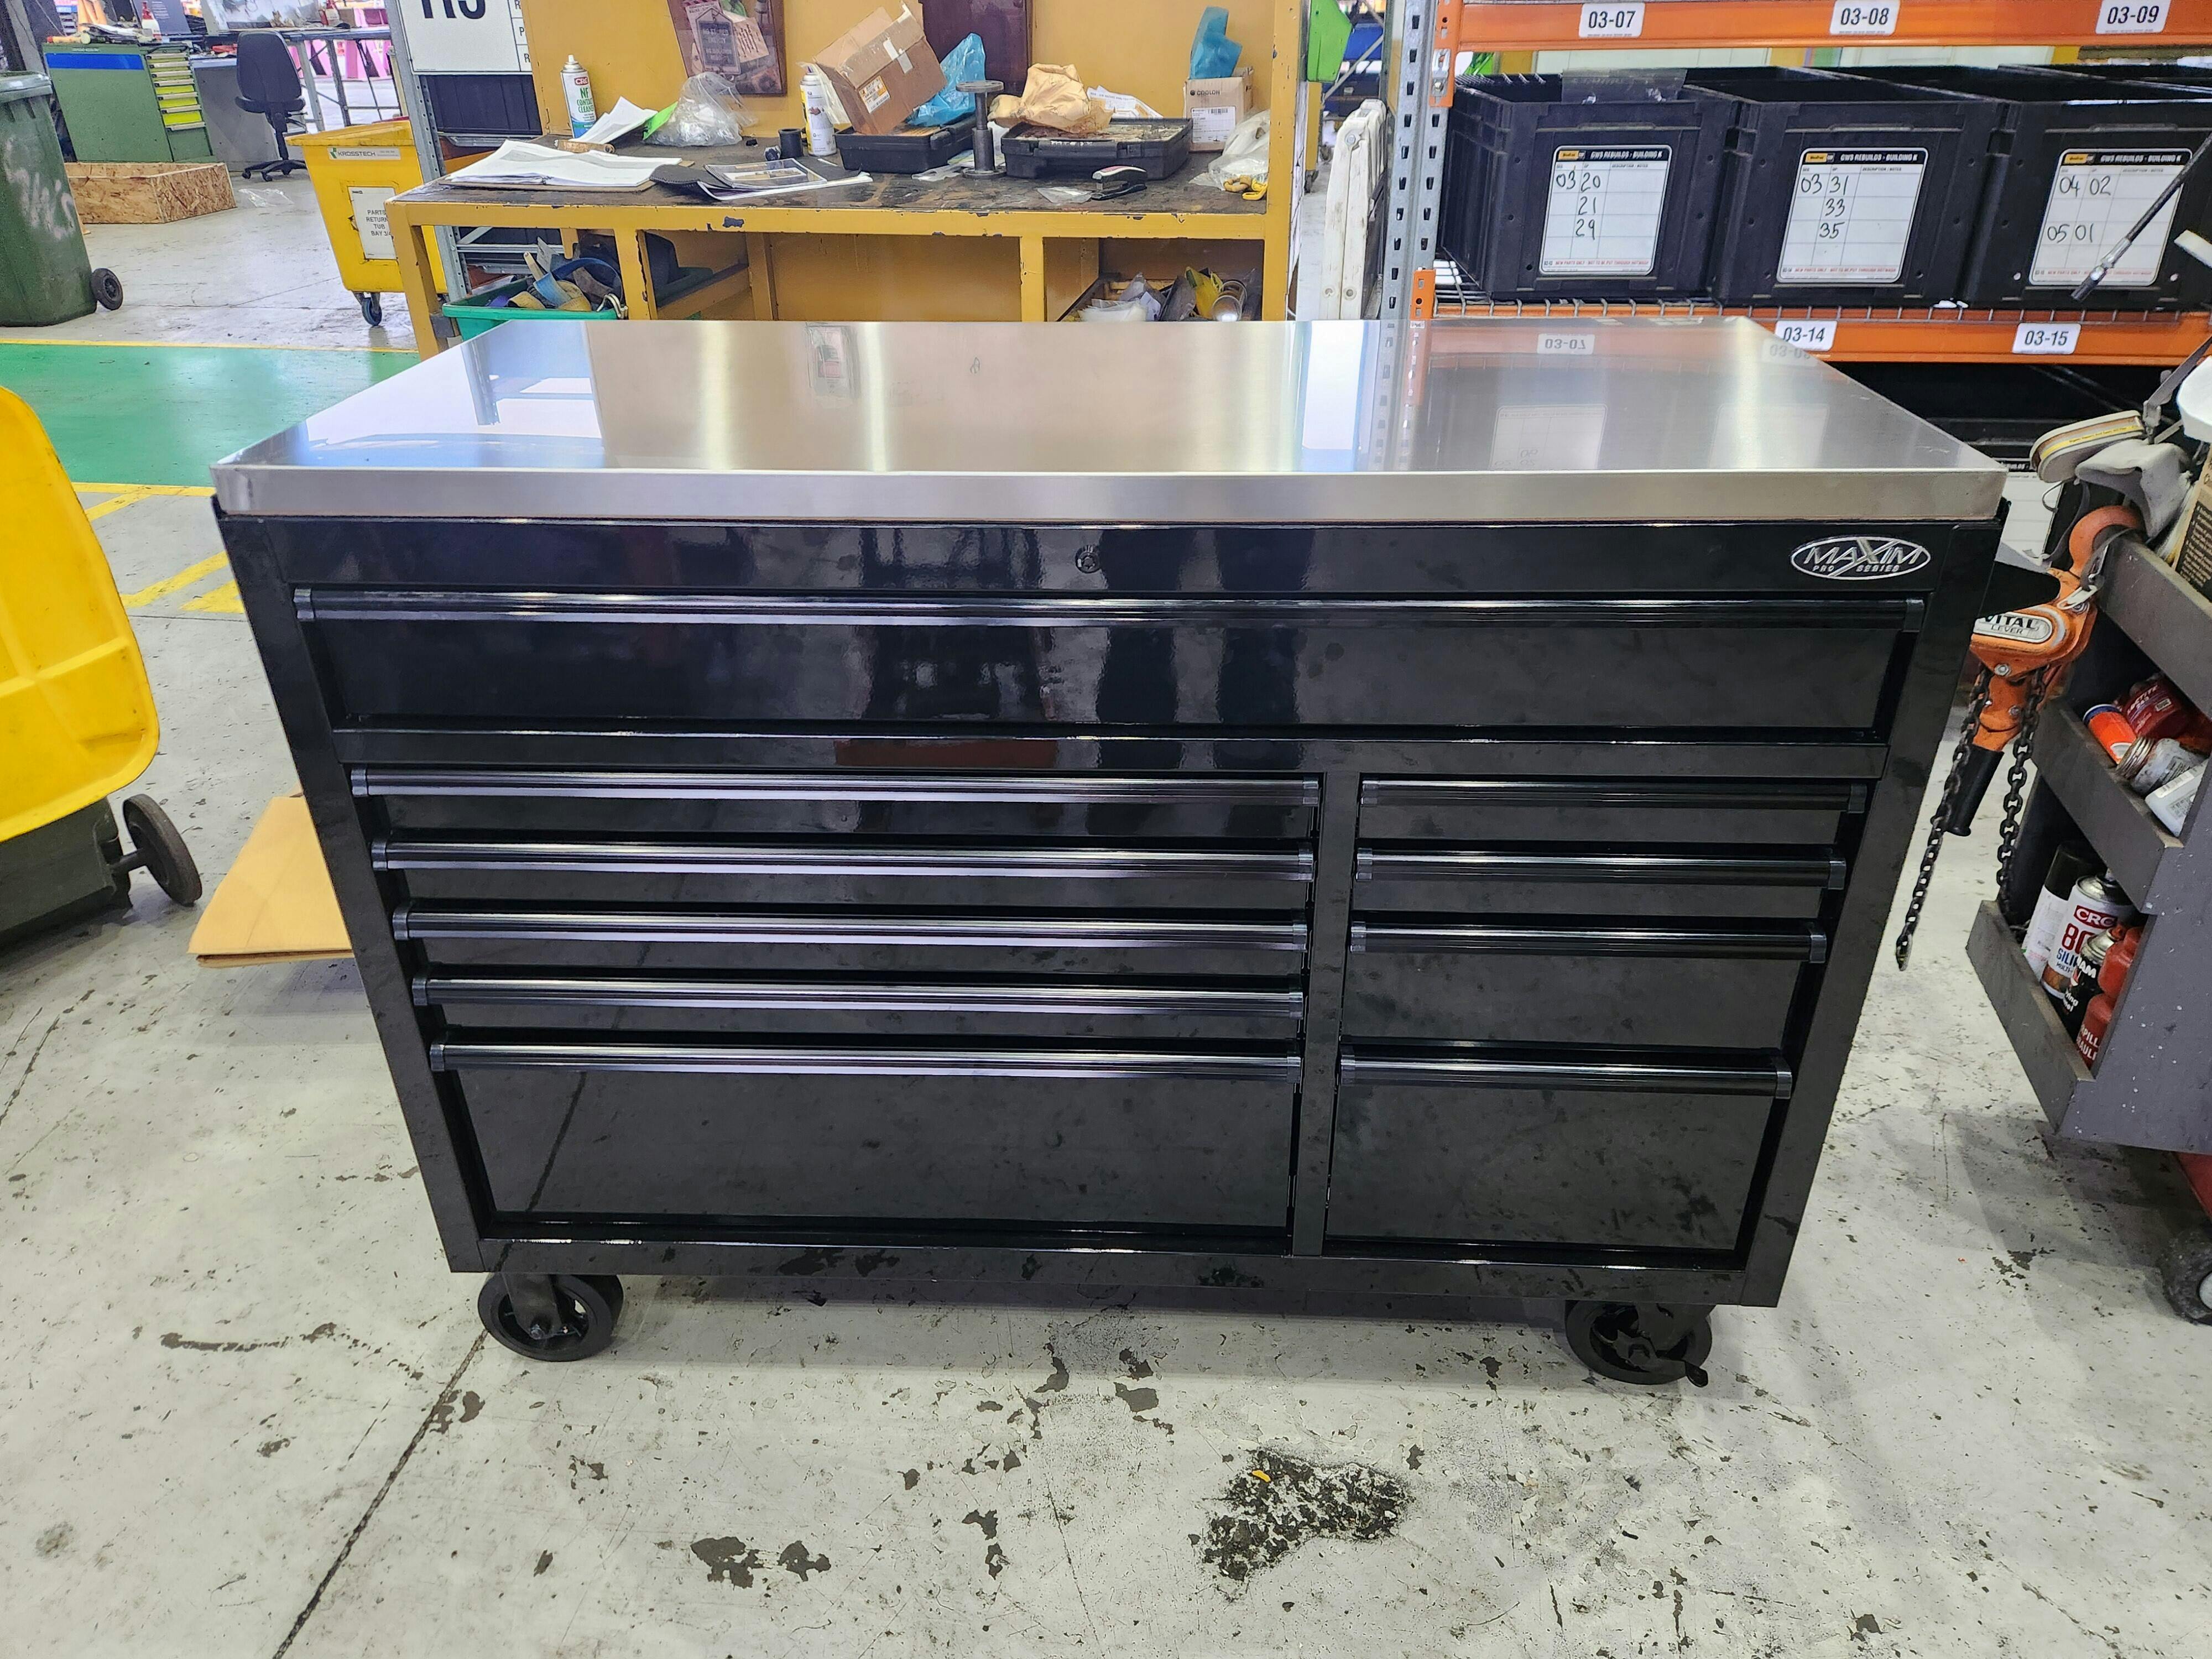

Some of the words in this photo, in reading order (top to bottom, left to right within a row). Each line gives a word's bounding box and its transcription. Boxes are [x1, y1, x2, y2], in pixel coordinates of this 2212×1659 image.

[1588, 11, 1636, 28] 03-07
[1840, 8, 1890, 25] 03-08
[2107, 6, 2159, 24] 03-09
[580, 87, 589, 98] NF
[1556, 170, 1576, 190] 03
[1580, 172, 1601, 192] 20
[1801, 174, 1822, 194] 03
[1829, 175, 1849, 196] 31
[2059, 175, 2080, 197] 04
[2090, 176, 2111, 196] 02
[1578, 196, 1597, 216] 21
[1825, 198, 1845, 217] 33
[1575, 218, 1595, 240] 29
[1819, 222, 1845, 239] 35
[2047, 224, 2070, 243] 05
[2075, 223, 2094, 243] 01
[1783, 327, 1826, 342] 03-14
[2025, 330, 2069, 346] 03-15
[1803, 540, 1923, 566] MAXIM
[2077, 907, 2114, 927] CRC
